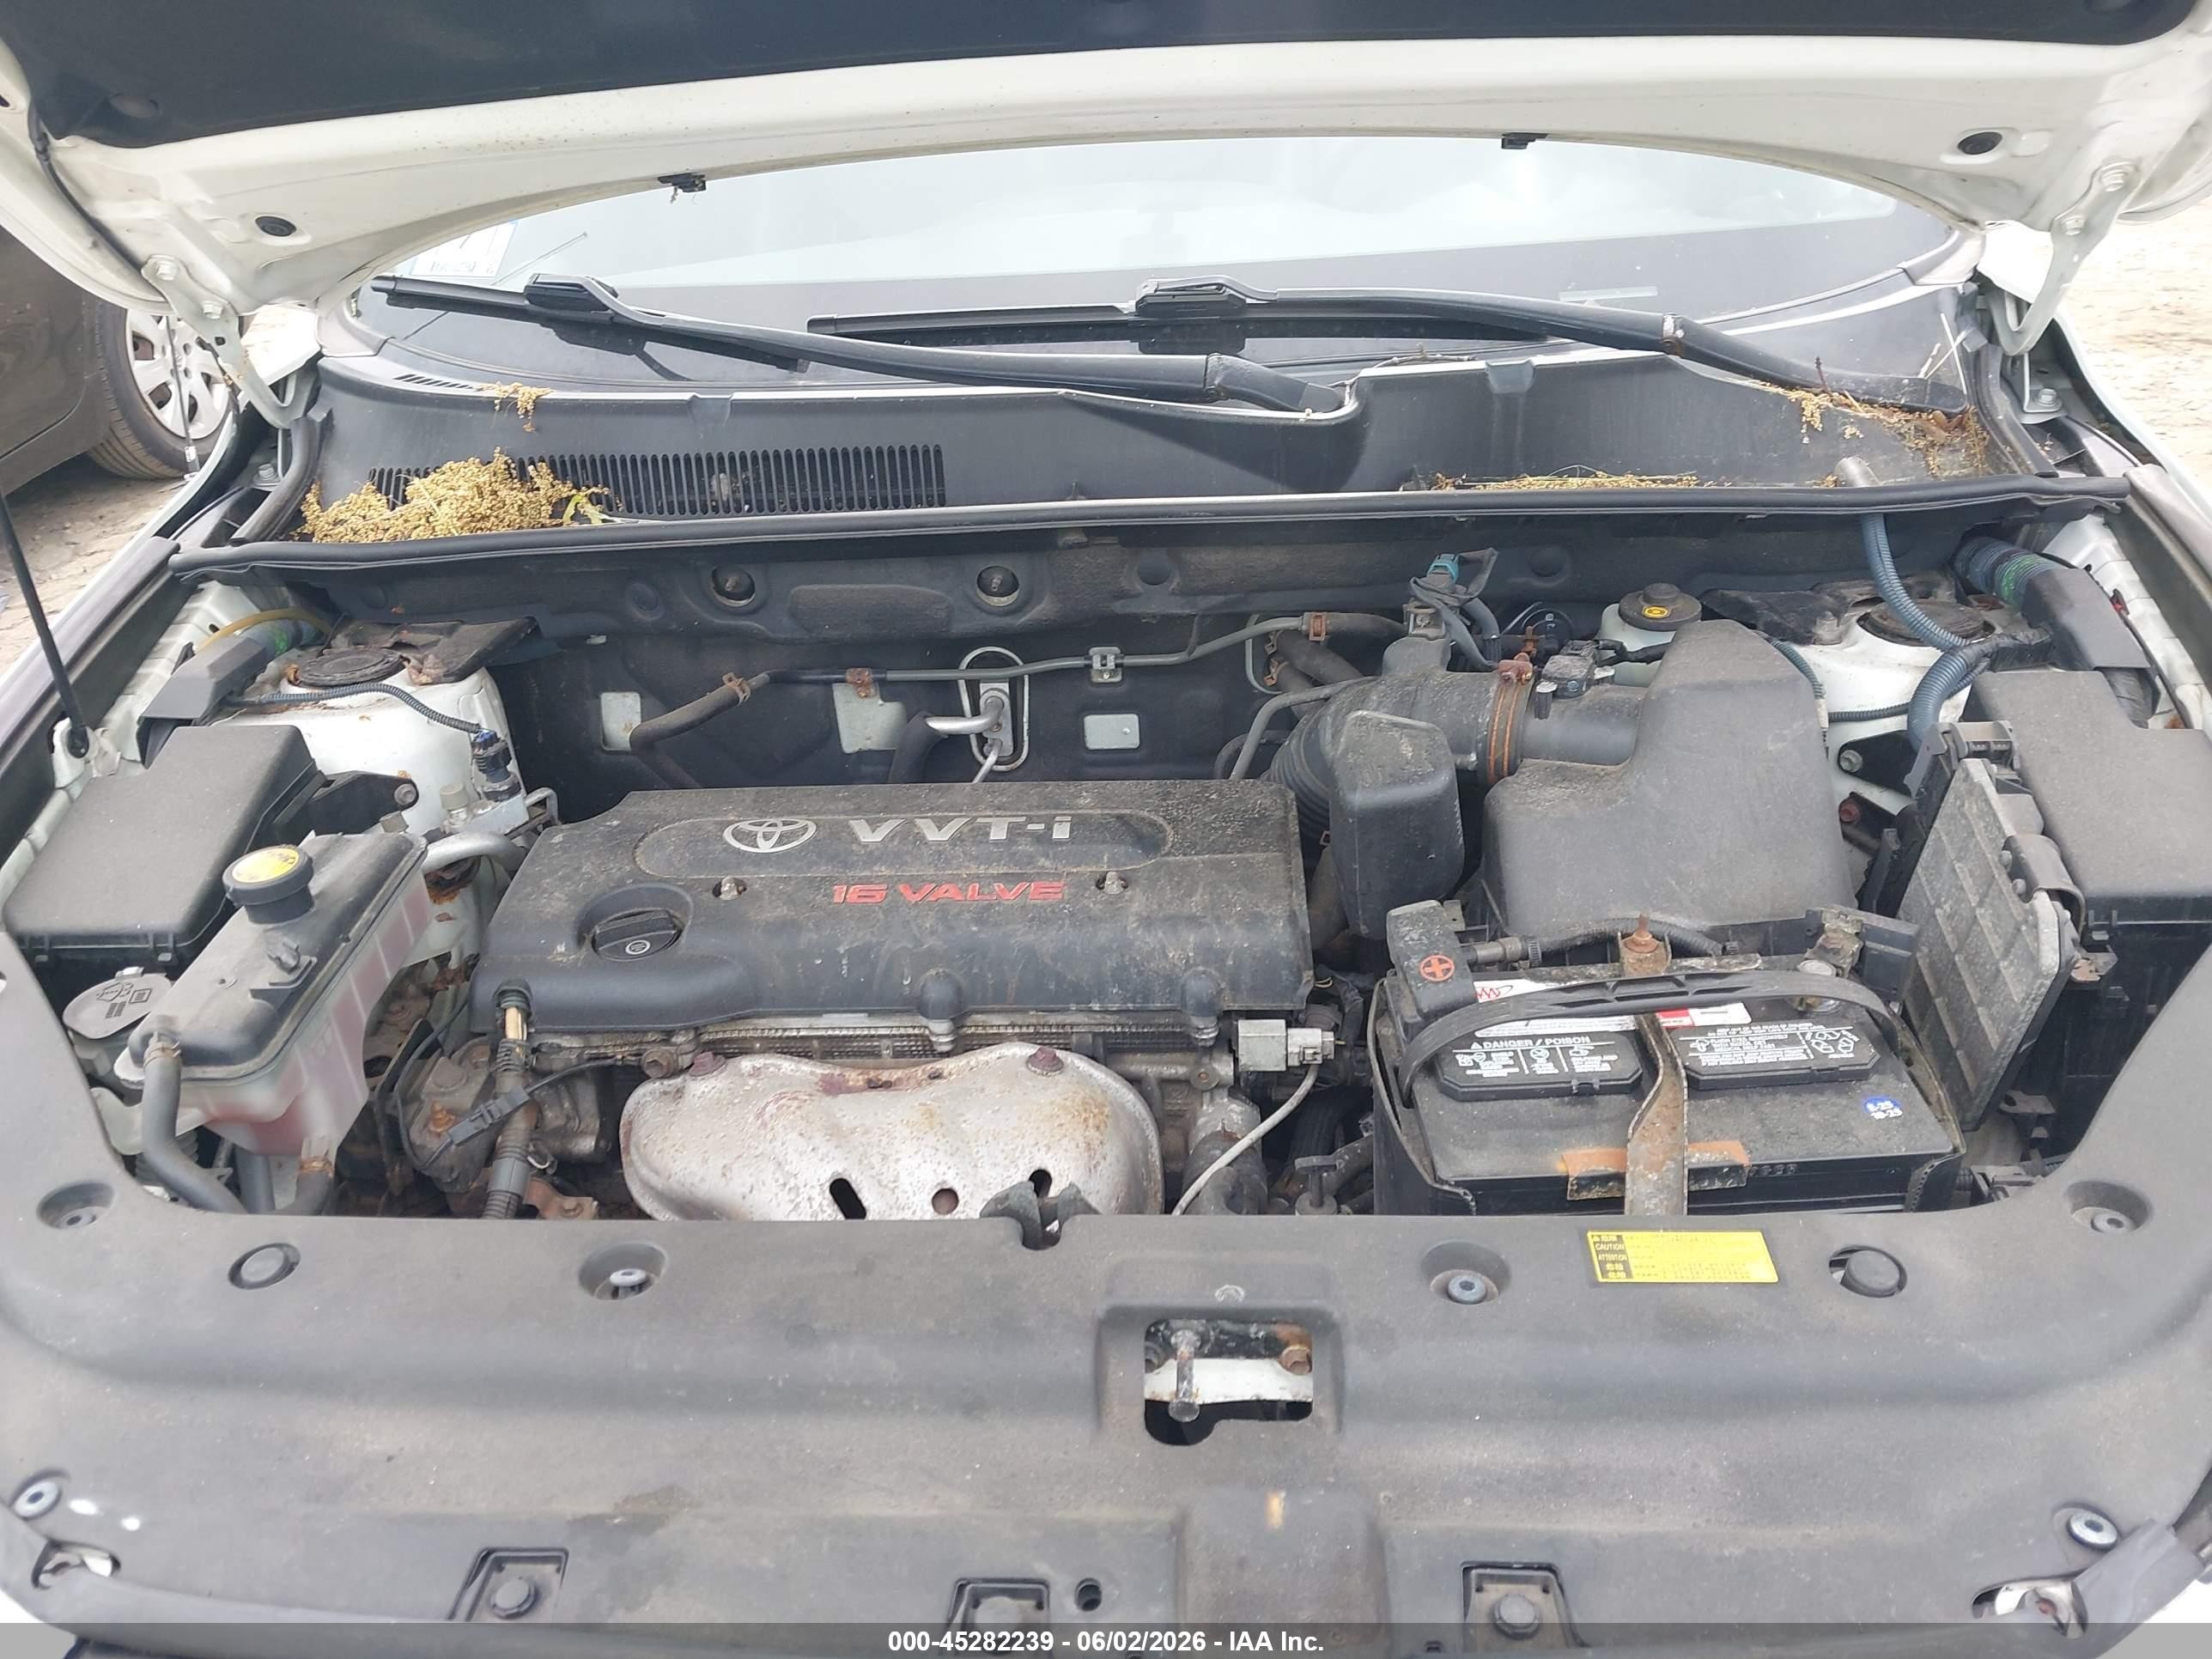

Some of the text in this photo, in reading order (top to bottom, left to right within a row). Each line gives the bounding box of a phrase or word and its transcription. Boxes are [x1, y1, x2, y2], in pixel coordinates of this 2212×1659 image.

[848, 817, 1073, 842] VVT-i
[832, 882, 1066, 904] 16 VALVE
[1482, 1037, 1533, 1048] DANGER
[1545, 1036, 1590, 1046] POISON
[1595, 1243, 1626, 1251] CAUTION
